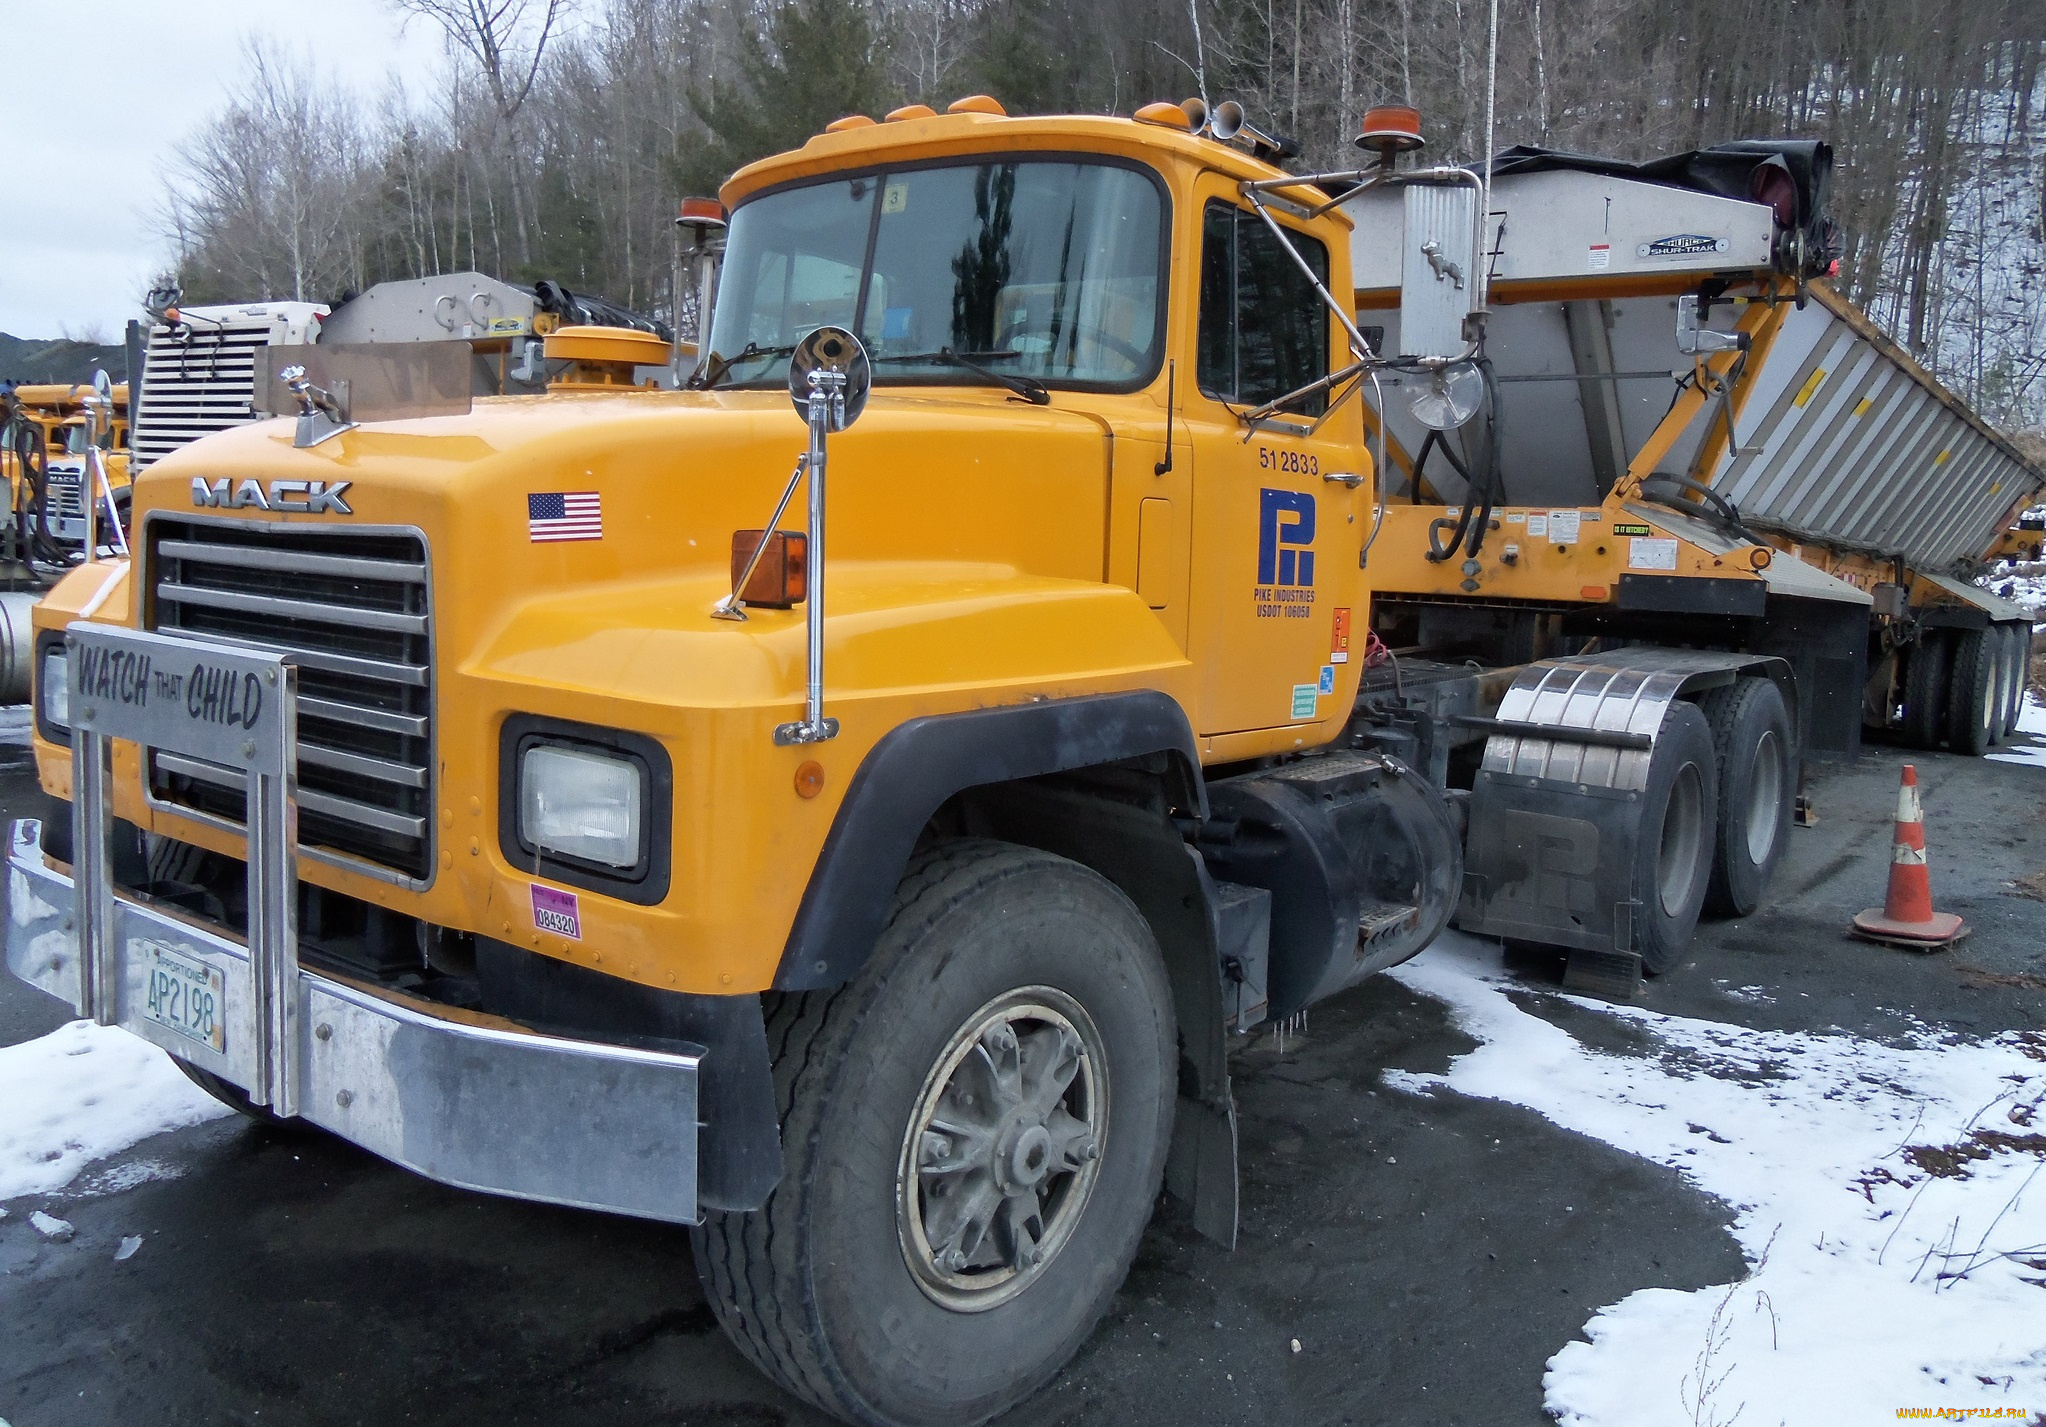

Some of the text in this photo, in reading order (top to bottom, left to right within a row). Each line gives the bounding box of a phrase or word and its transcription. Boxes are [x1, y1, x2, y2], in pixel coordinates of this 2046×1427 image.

[890, 191, 899, 205] 3
[1650, 245, 1714, 255] SHUR-TRAK
[1259, 447, 1319, 476] 512833
[50, 475, 77, 483] MACK
[192, 476, 353, 514] MACK
[1254, 588, 1315, 603] PIKE INDUSTRIES
[1257, 604, 1310, 618] USDOT 106058
[79, 643, 262, 730] WATCH THAT CHILD
[538, 909, 575, 934] 084320
[148, 968, 214, 1036] AP2198
